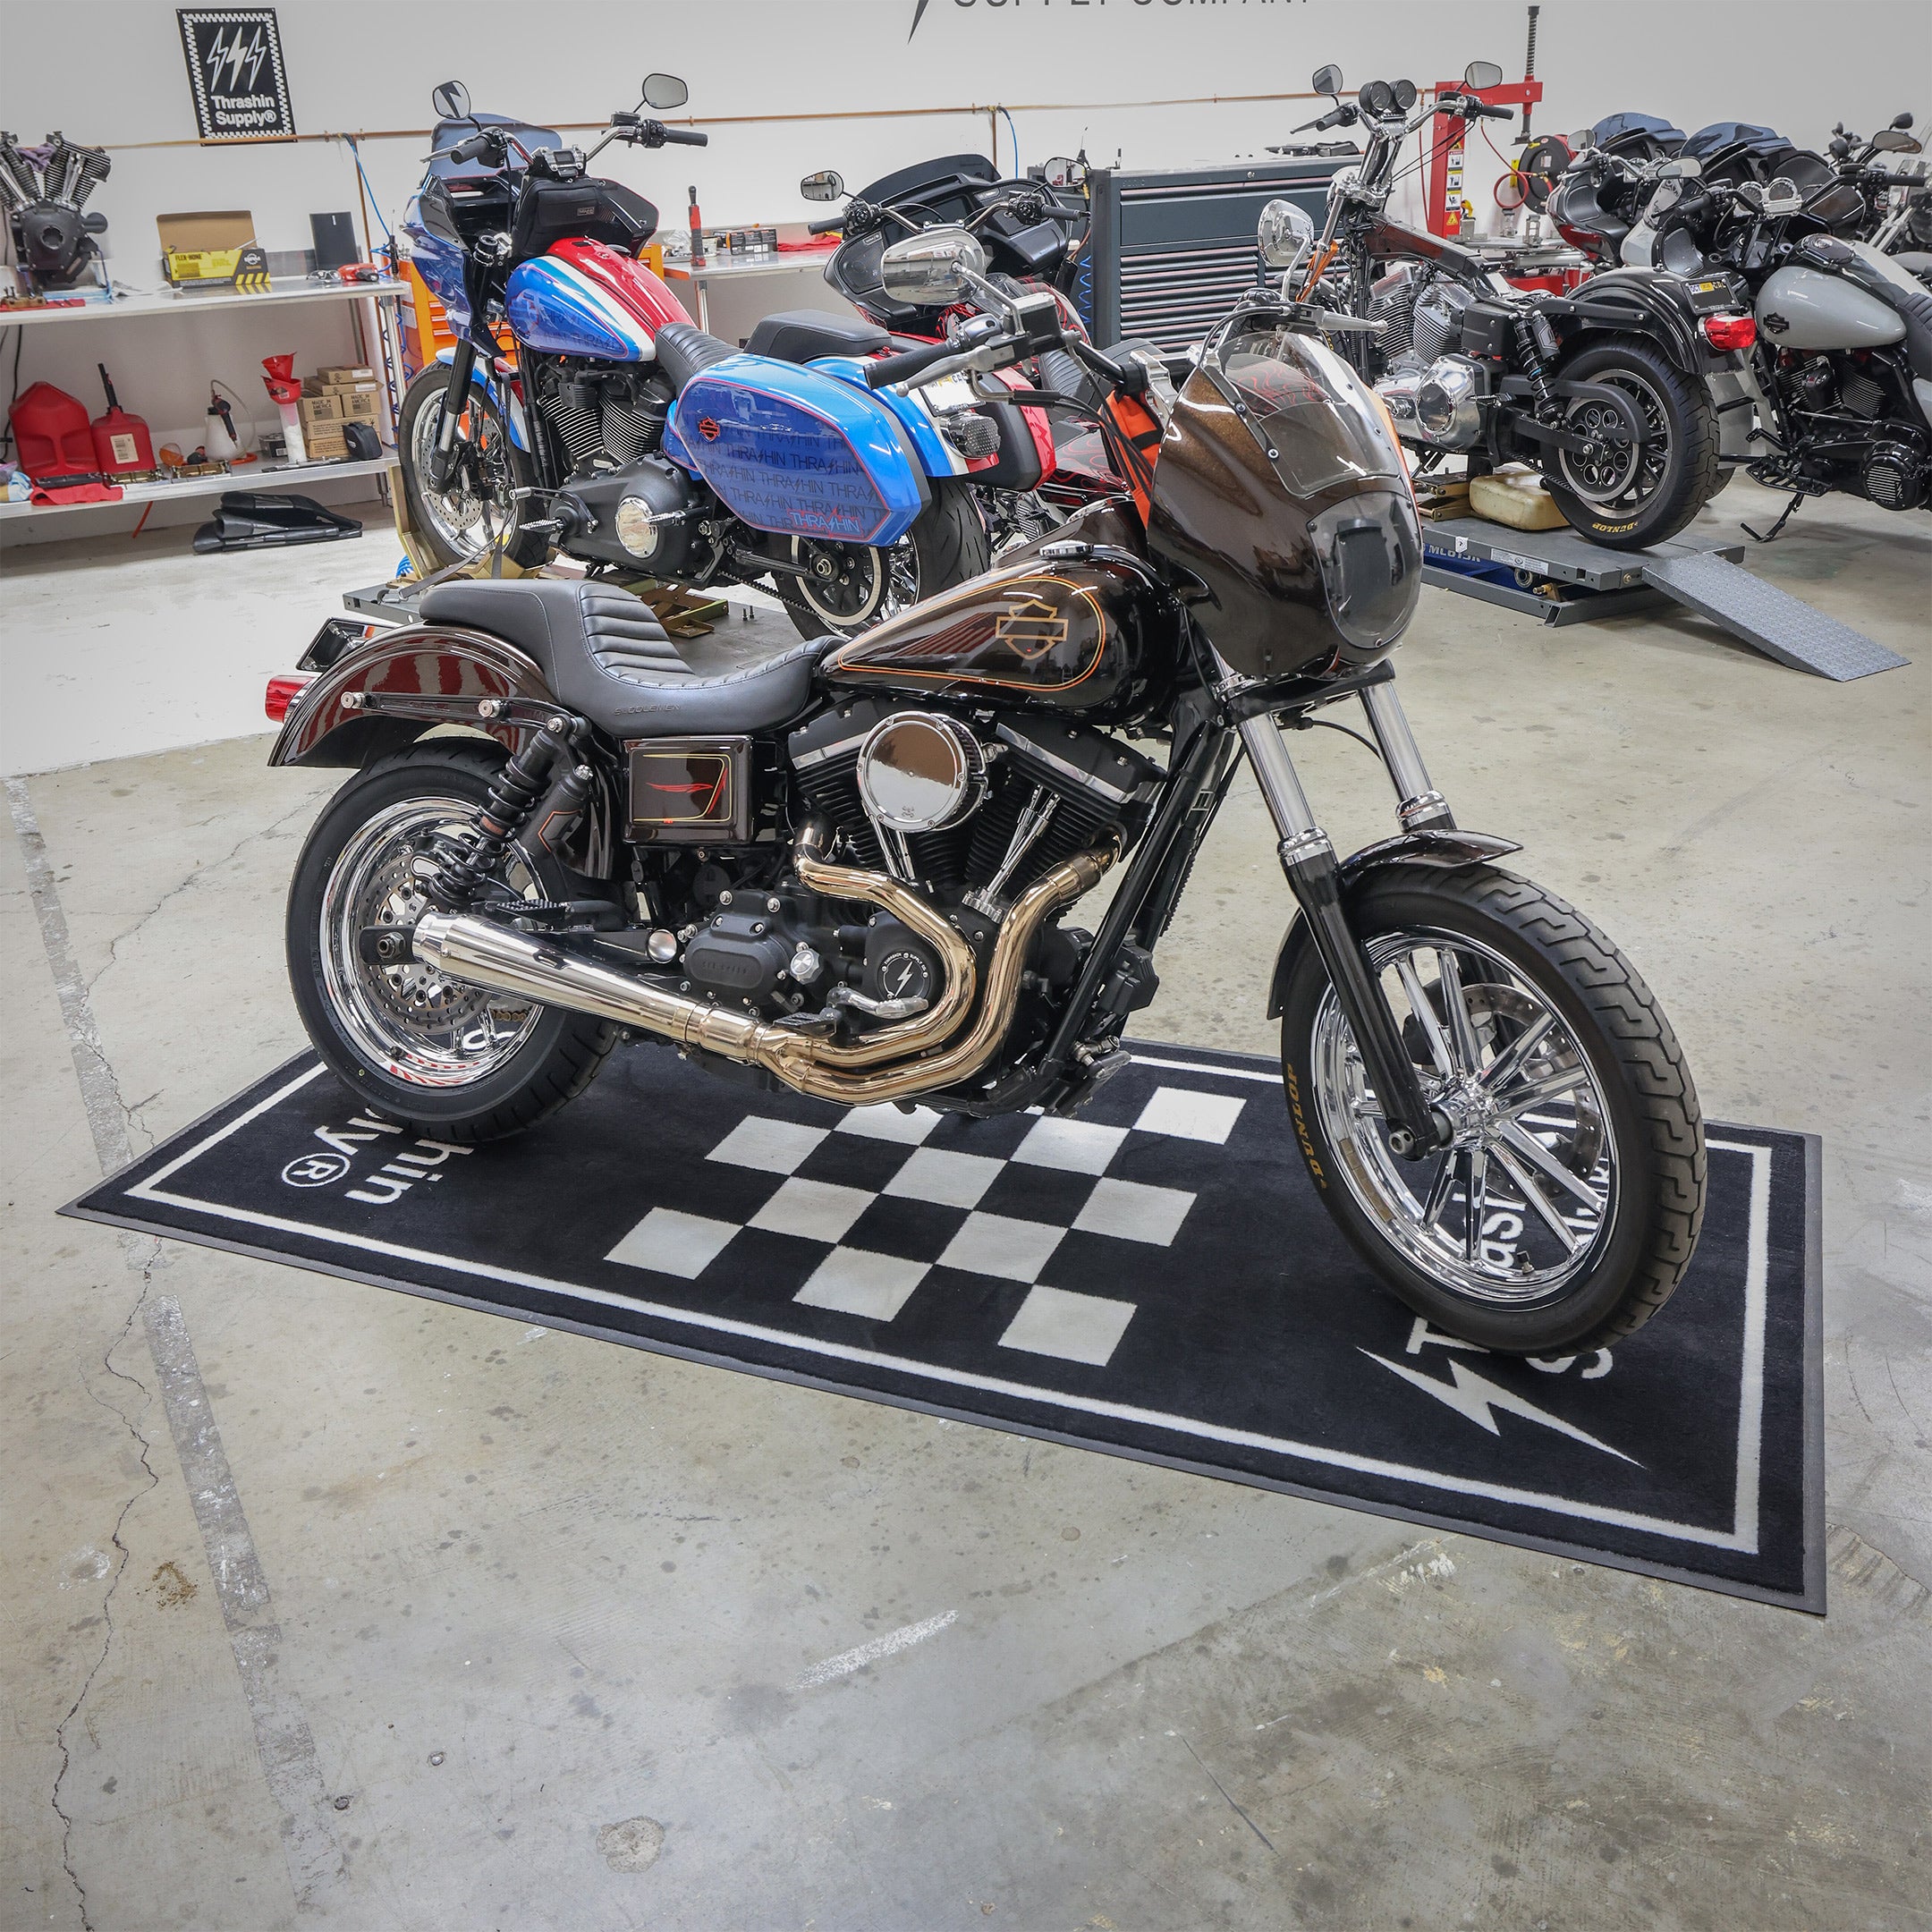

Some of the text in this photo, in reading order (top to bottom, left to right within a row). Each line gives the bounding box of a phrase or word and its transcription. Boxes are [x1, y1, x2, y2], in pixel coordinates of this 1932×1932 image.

[210, 95, 275, 109] Thrashin
[1591, 522, 1635, 533] DUNLOP
[1286, 1063, 1325, 1178] DUNLOP
